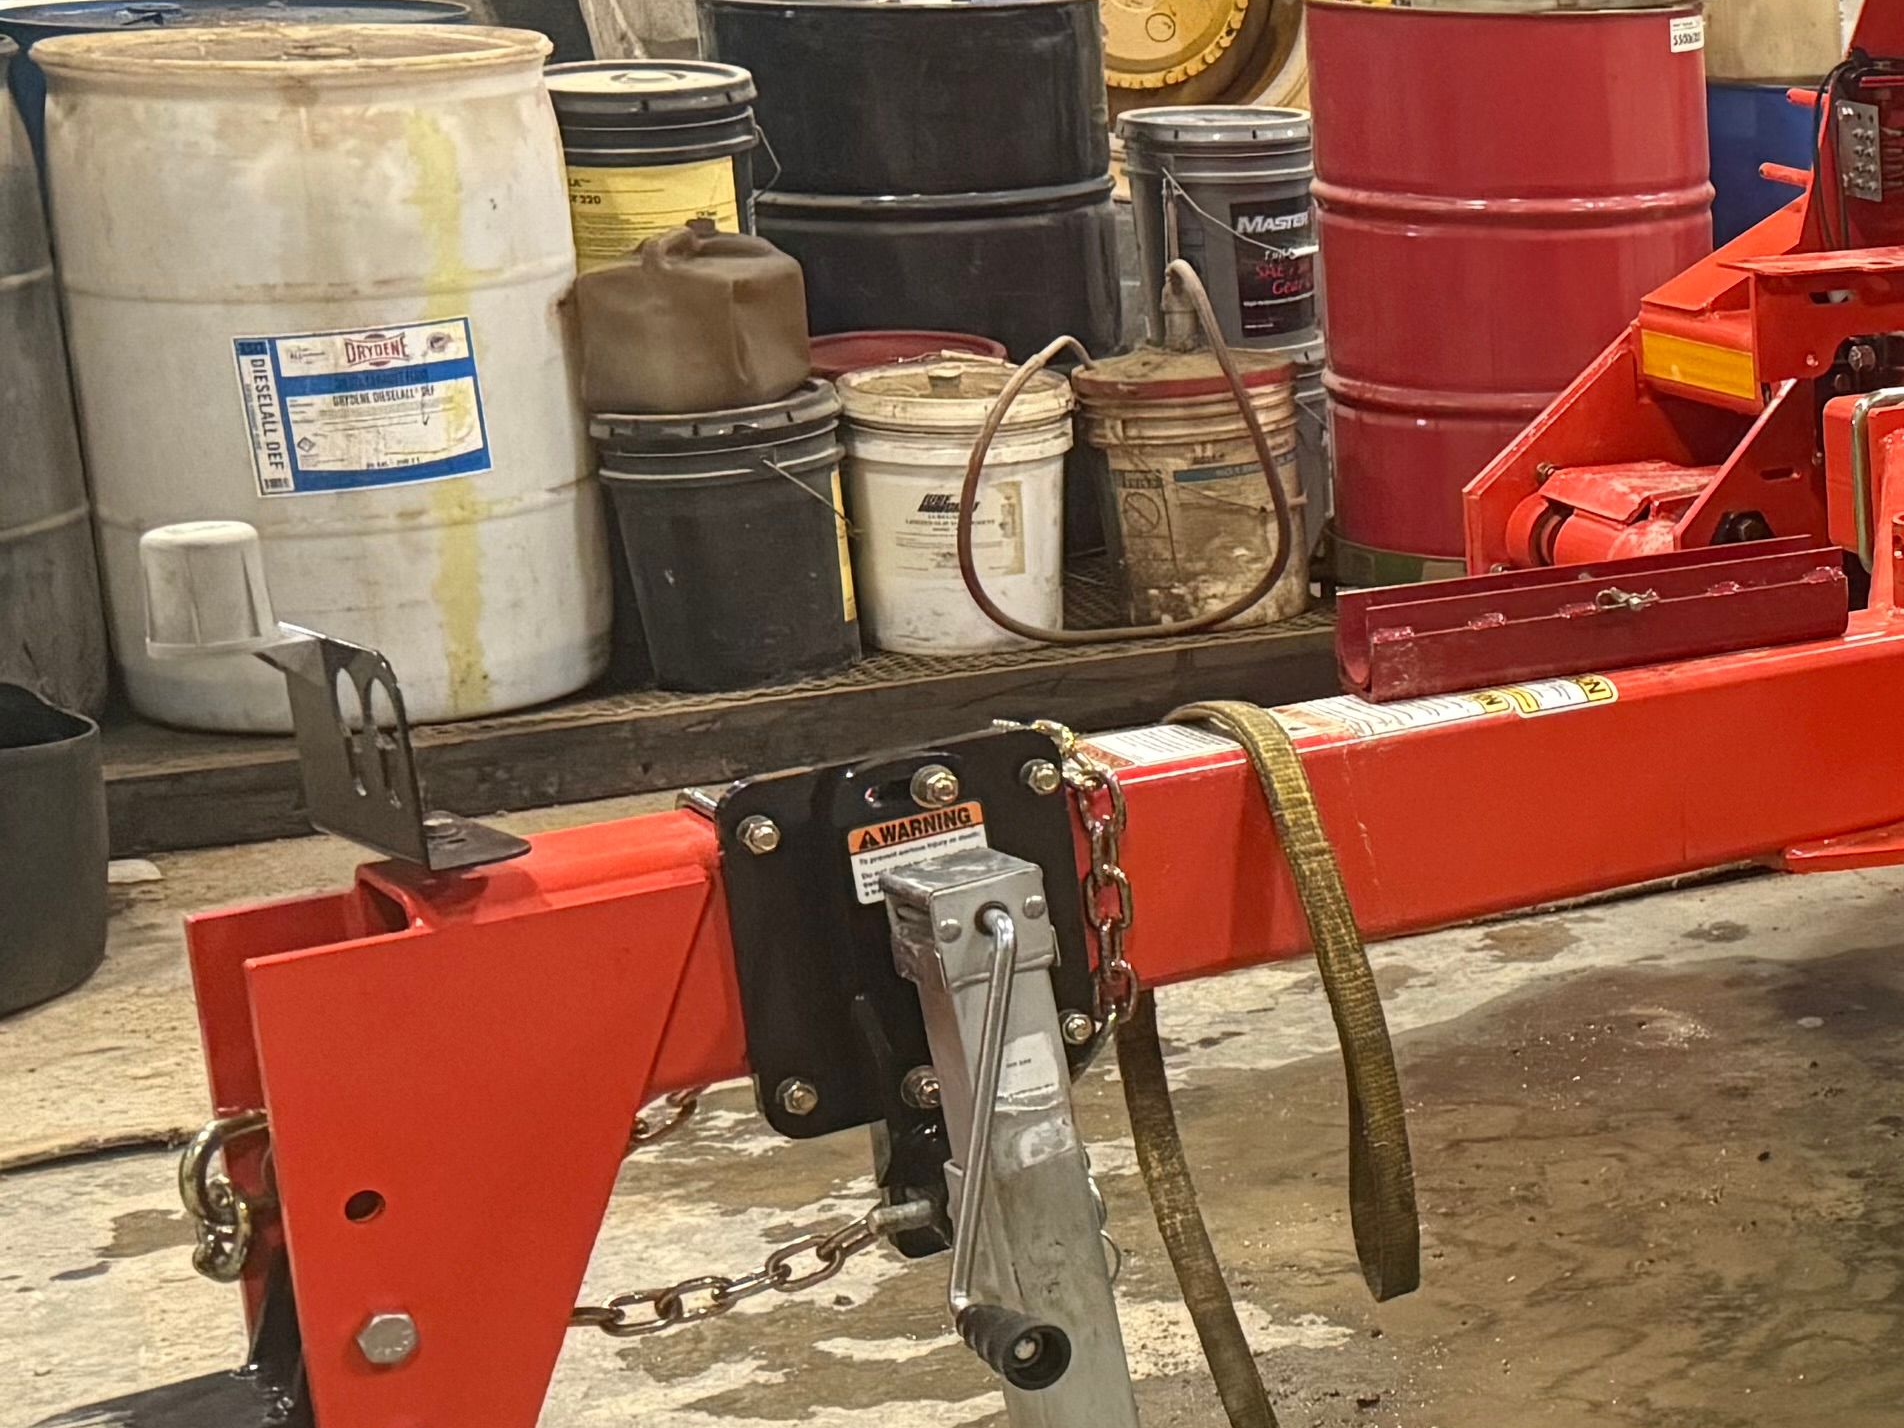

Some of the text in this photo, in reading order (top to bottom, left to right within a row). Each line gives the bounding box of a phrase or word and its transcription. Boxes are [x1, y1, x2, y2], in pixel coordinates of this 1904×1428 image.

[344, 333, 409, 364] DRYDENE
[250, 358, 275, 437] DIESELALL
[266, 442, 285, 470] DEF
[879, 806, 972, 844] WARNING
